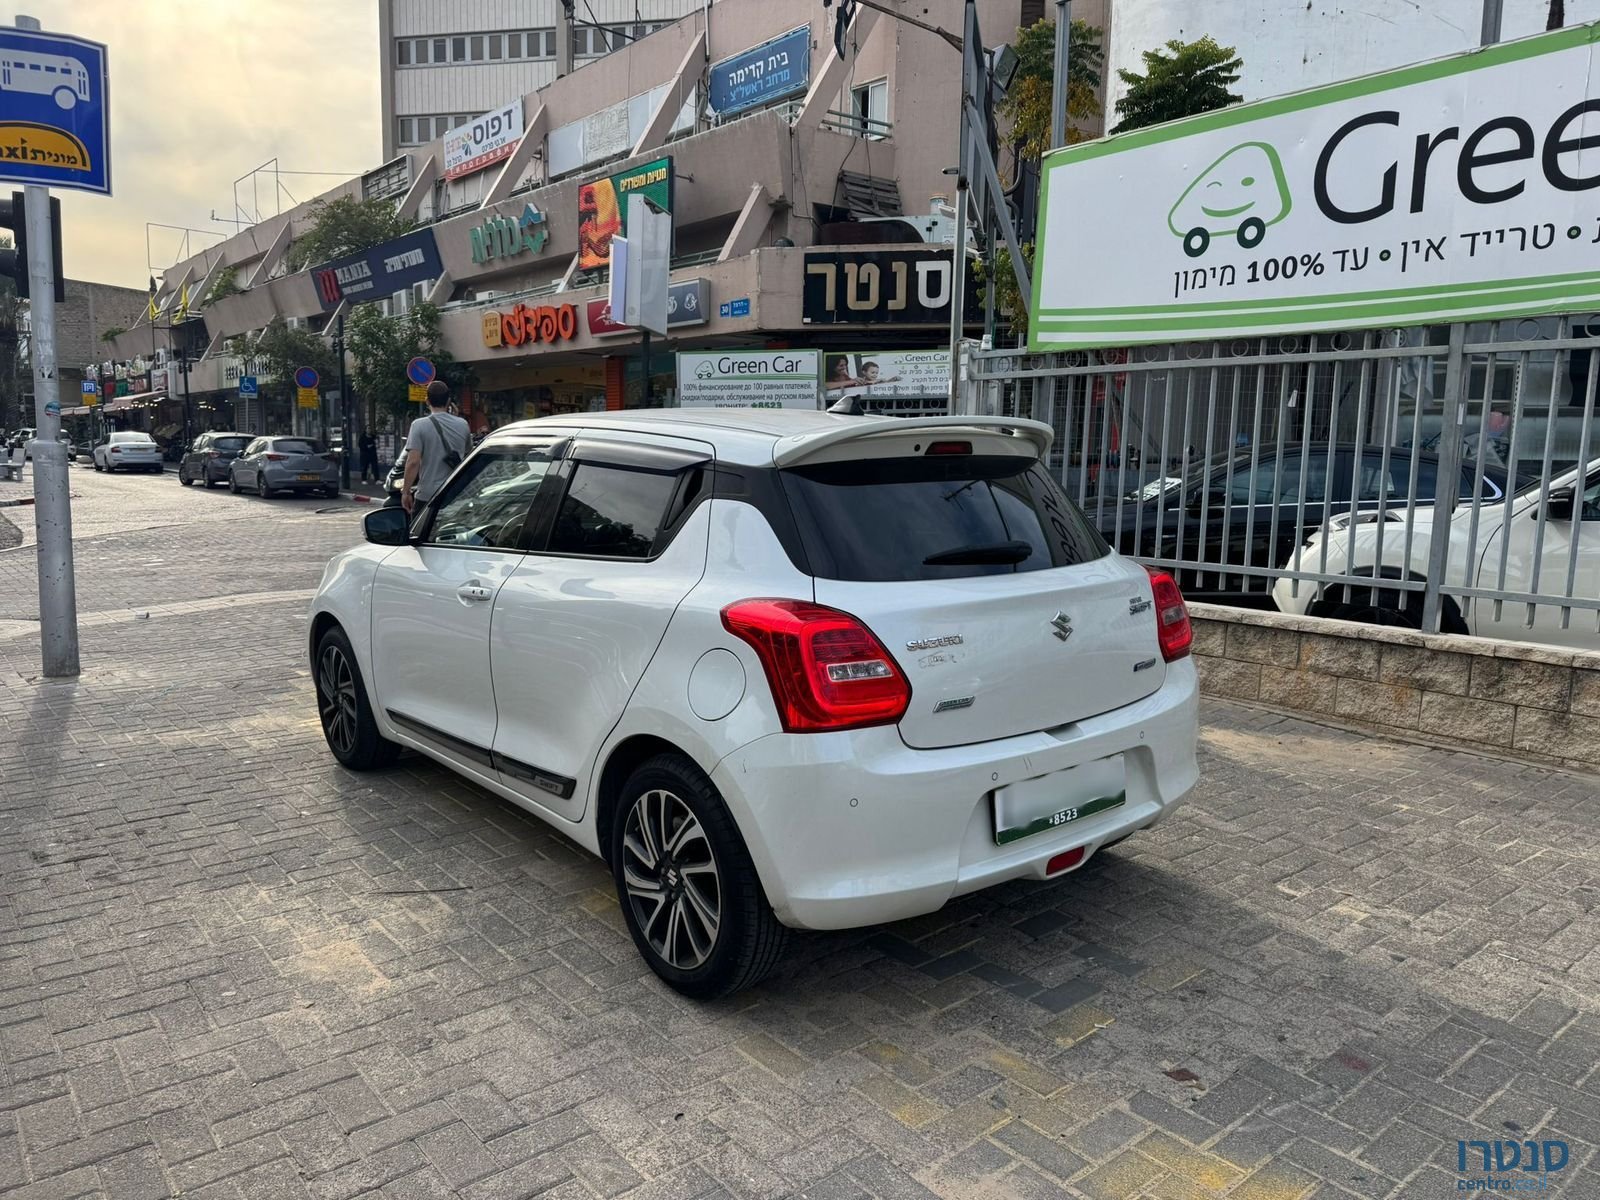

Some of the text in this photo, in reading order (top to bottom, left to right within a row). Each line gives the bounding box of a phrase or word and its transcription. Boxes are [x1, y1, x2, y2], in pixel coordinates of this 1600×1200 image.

[768, 52, 789, 71] בית
[473, 108, 513, 145] דפוס
[30, 147, 78, 165] מונית
[1460, 223, 1556, 257] טרייד
[1246, 252, 1325, 283] 100%
[1332, 246, 1369, 272] עד
[1400, 236, 1448, 273] אין
[807, 260, 951, 312] סנטר
[1174, 264, 1236, 298] מימון
[718, 356, 802, 374] Green Car
[905, 353, 949, 362] Green Car
[683, 383, 697, 391] 100%
[753, 382, 763, 390] 100
[906, 634, 964, 651] SUZUKI
